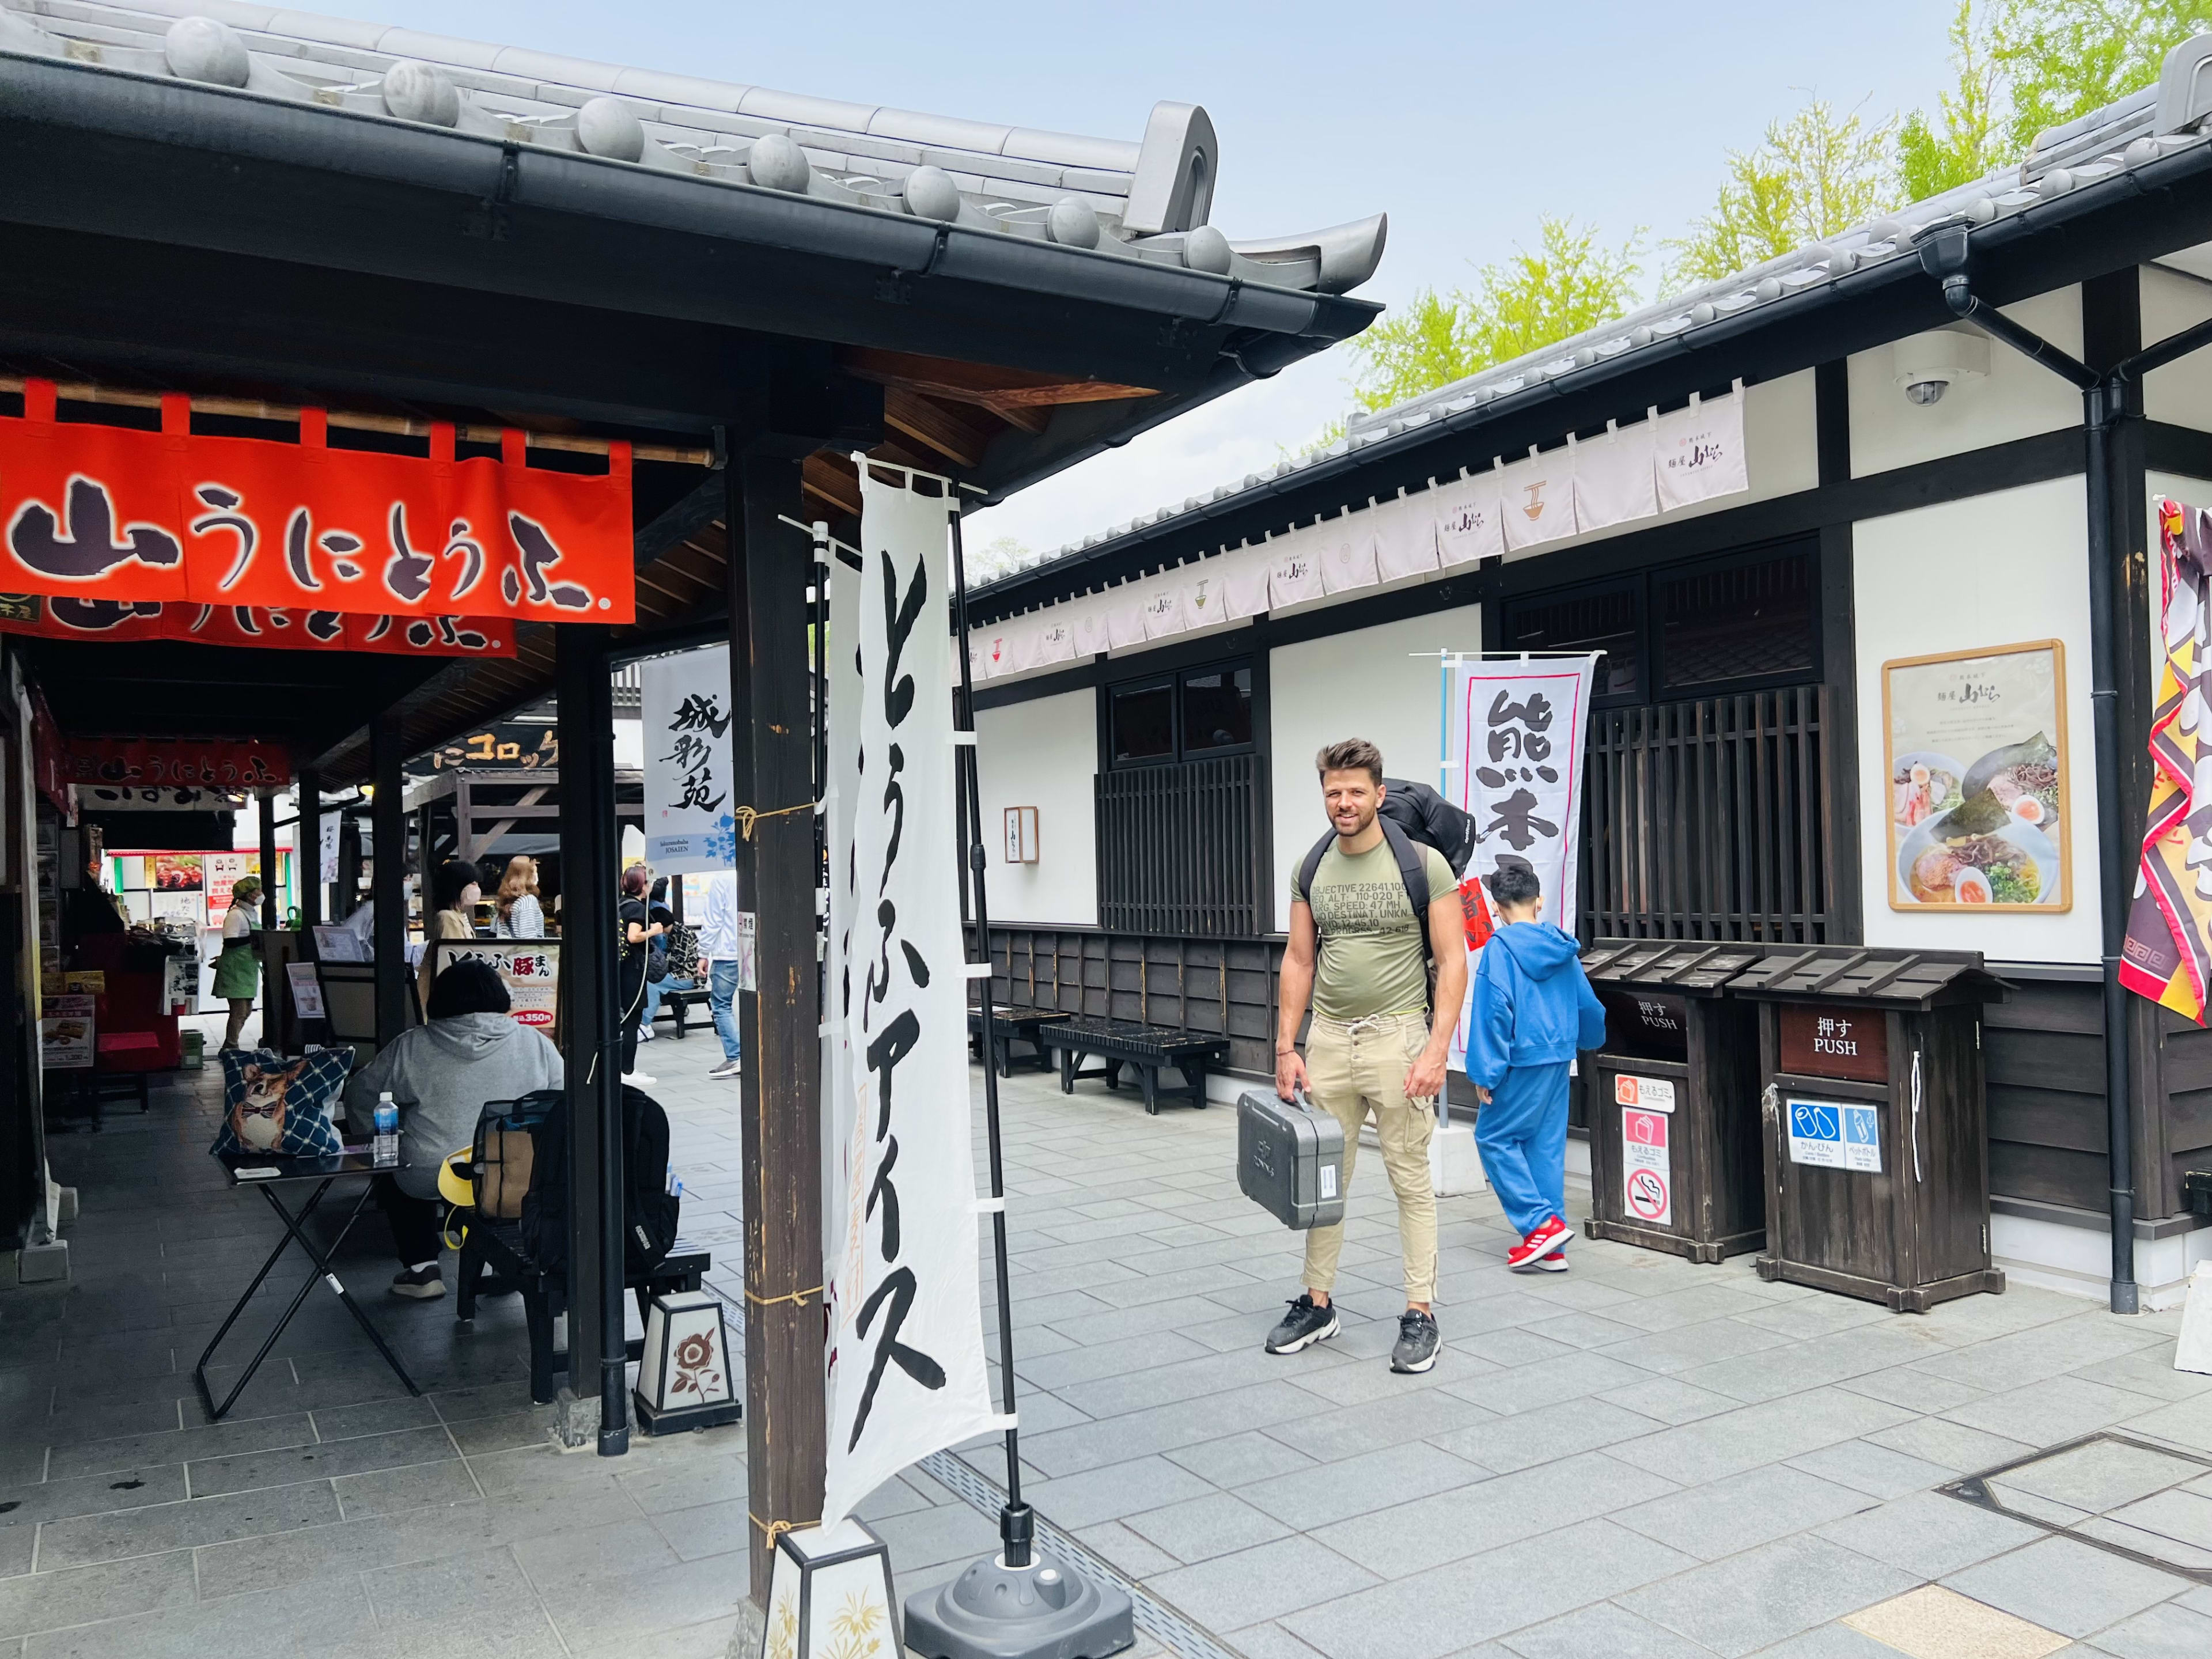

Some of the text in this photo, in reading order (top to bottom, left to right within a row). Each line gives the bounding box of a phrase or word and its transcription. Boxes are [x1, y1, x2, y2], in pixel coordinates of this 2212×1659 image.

[10, 477, 590, 608] 山うにとうふ
[659, 694, 731, 813] 城彩苑
[665, 846, 689, 854] JOSAIEN
[1328, 893, 1349, 903] ALT:
[1356, 892, 1392, 901] 110-020
[1334, 901, 1368, 911] SPEED:
[1370, 901, 1383, 910] 47
[849, 550, 946, 1455] とうふアイス
[1638, 1000, 1666, 1016] 押す
[1641, 1015, 1678, 1030] PUSH
[1817, 1017, 1853, 1037] 押す
[1813, 1037, 1858, 1056] PUSH
